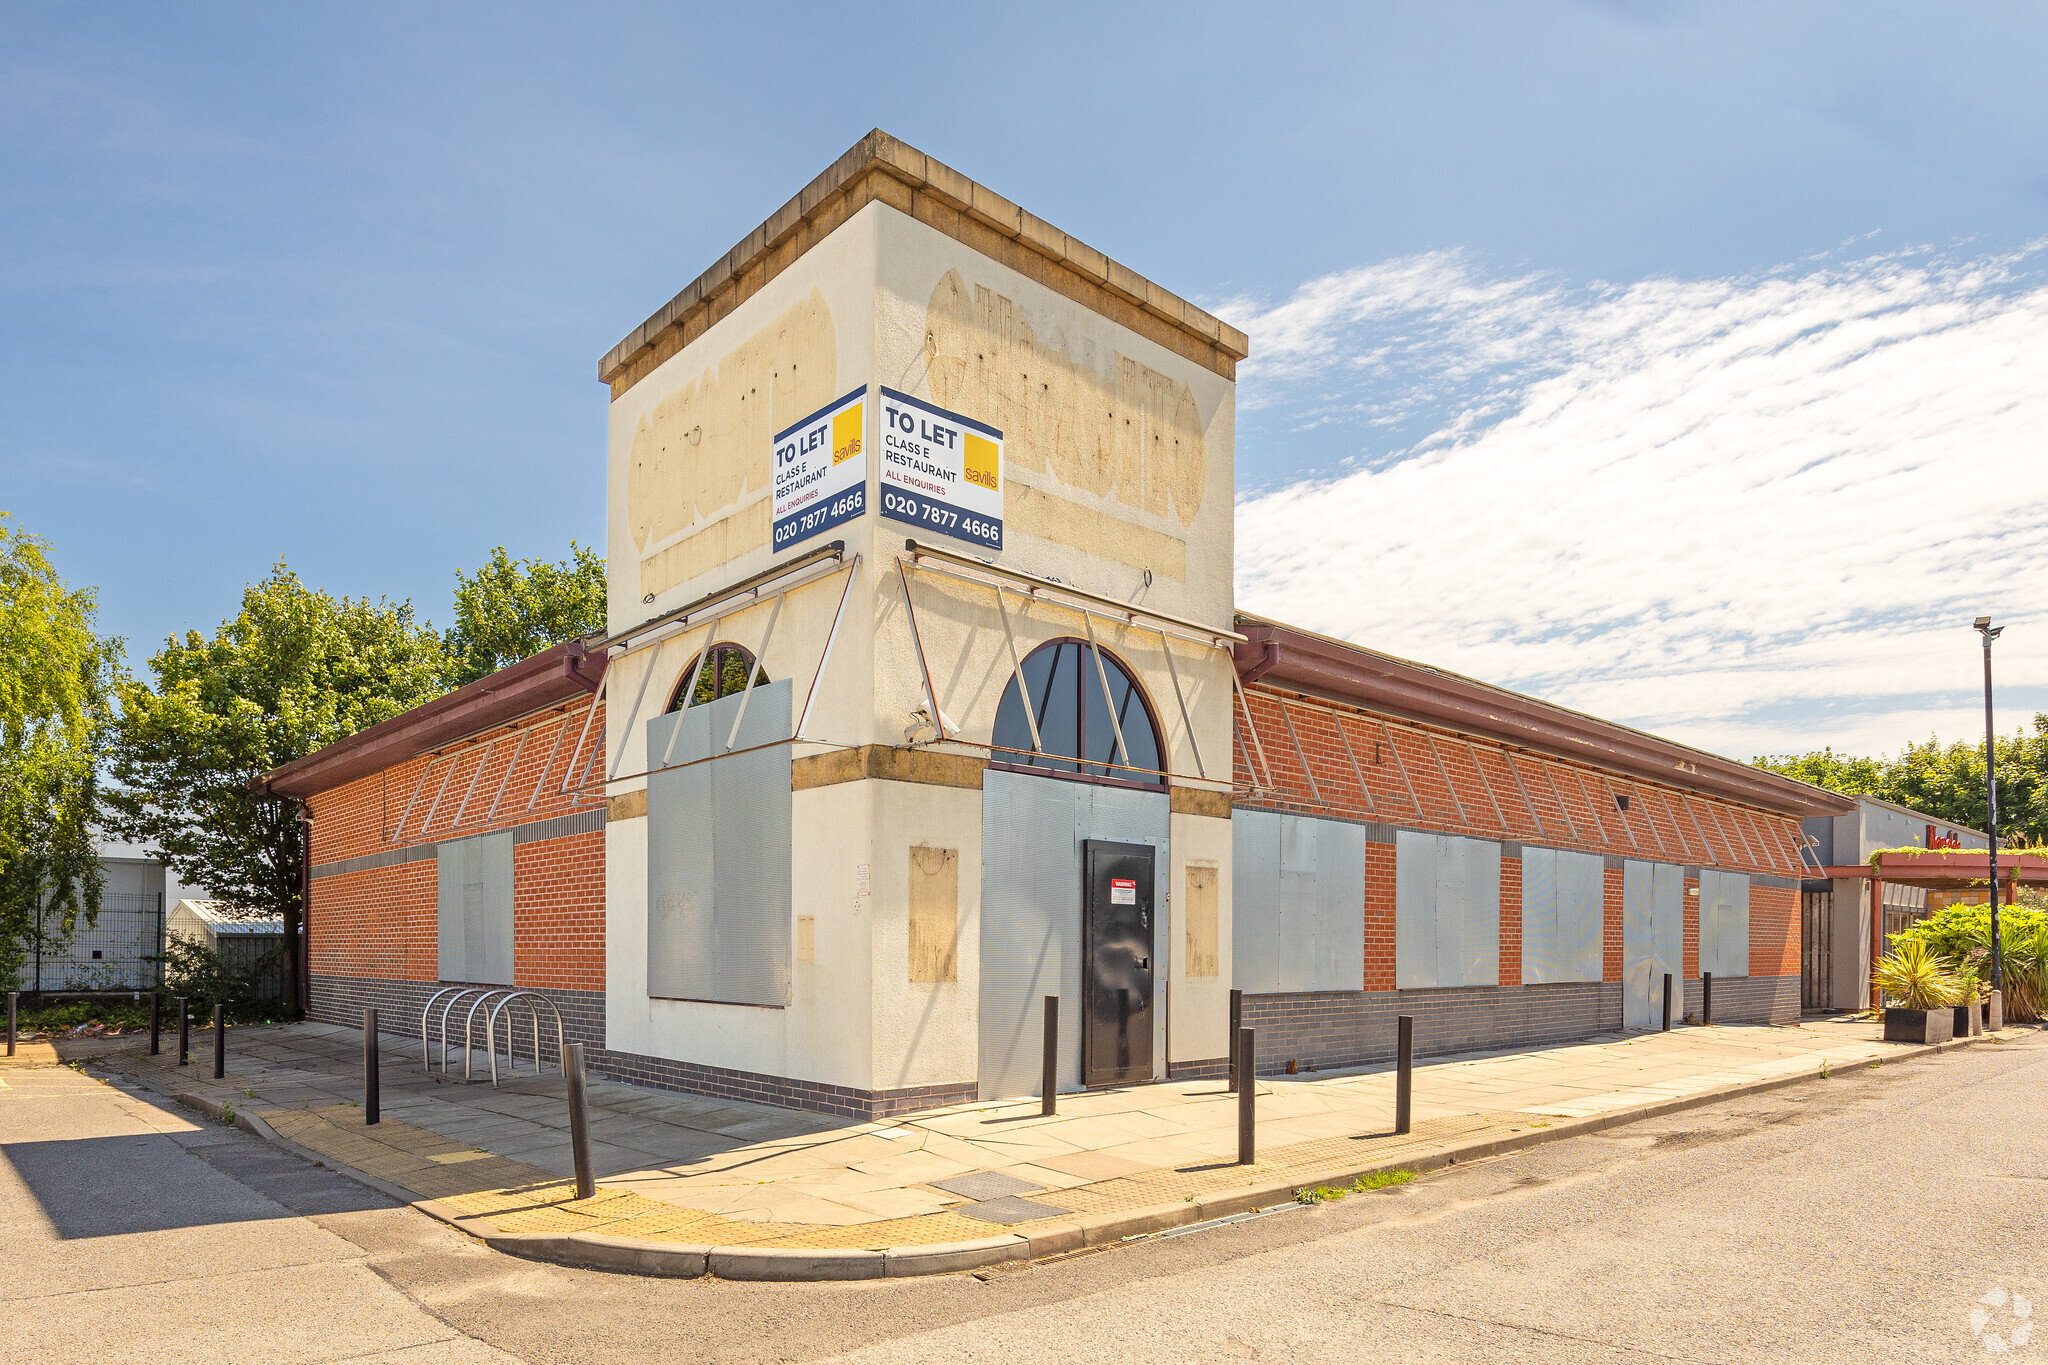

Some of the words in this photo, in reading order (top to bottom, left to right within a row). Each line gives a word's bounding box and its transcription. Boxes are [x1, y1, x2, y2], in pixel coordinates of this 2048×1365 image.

[885, 406, 915, 434] TO
[921, 419, 958, 449] LET
[777, 443, 796, 467] TO
[800, 424, 828, 456] LET
[833, 437, 861, 463] savills
[885, 434, 921, 455] CLASS
[923, 447, 930, 459] E
[776, 465, 800, 485] CLASS
[802, 461, 807, 473] E
[885, 450, 957, 483] RESTAURANT
[965, 467, 997, 489] savills
[776, 466, 828, 500] RESTAURANT
[885, 469, 902, 482] ALL
[903, 475, 946, 496] ENQUIRIES
[776, 505, 787, 515] ALL
[787, 488, 819, 510] ENQUIRIES
[775, 521, 797, 543] 020
[800, 506, 828, 533] 7877
[830, 491, 863, 518] 4666
[884, 493, 918, 516] 020
[921, 503, 958, 528] 7877
[961, 518, 999, 541] 4666
